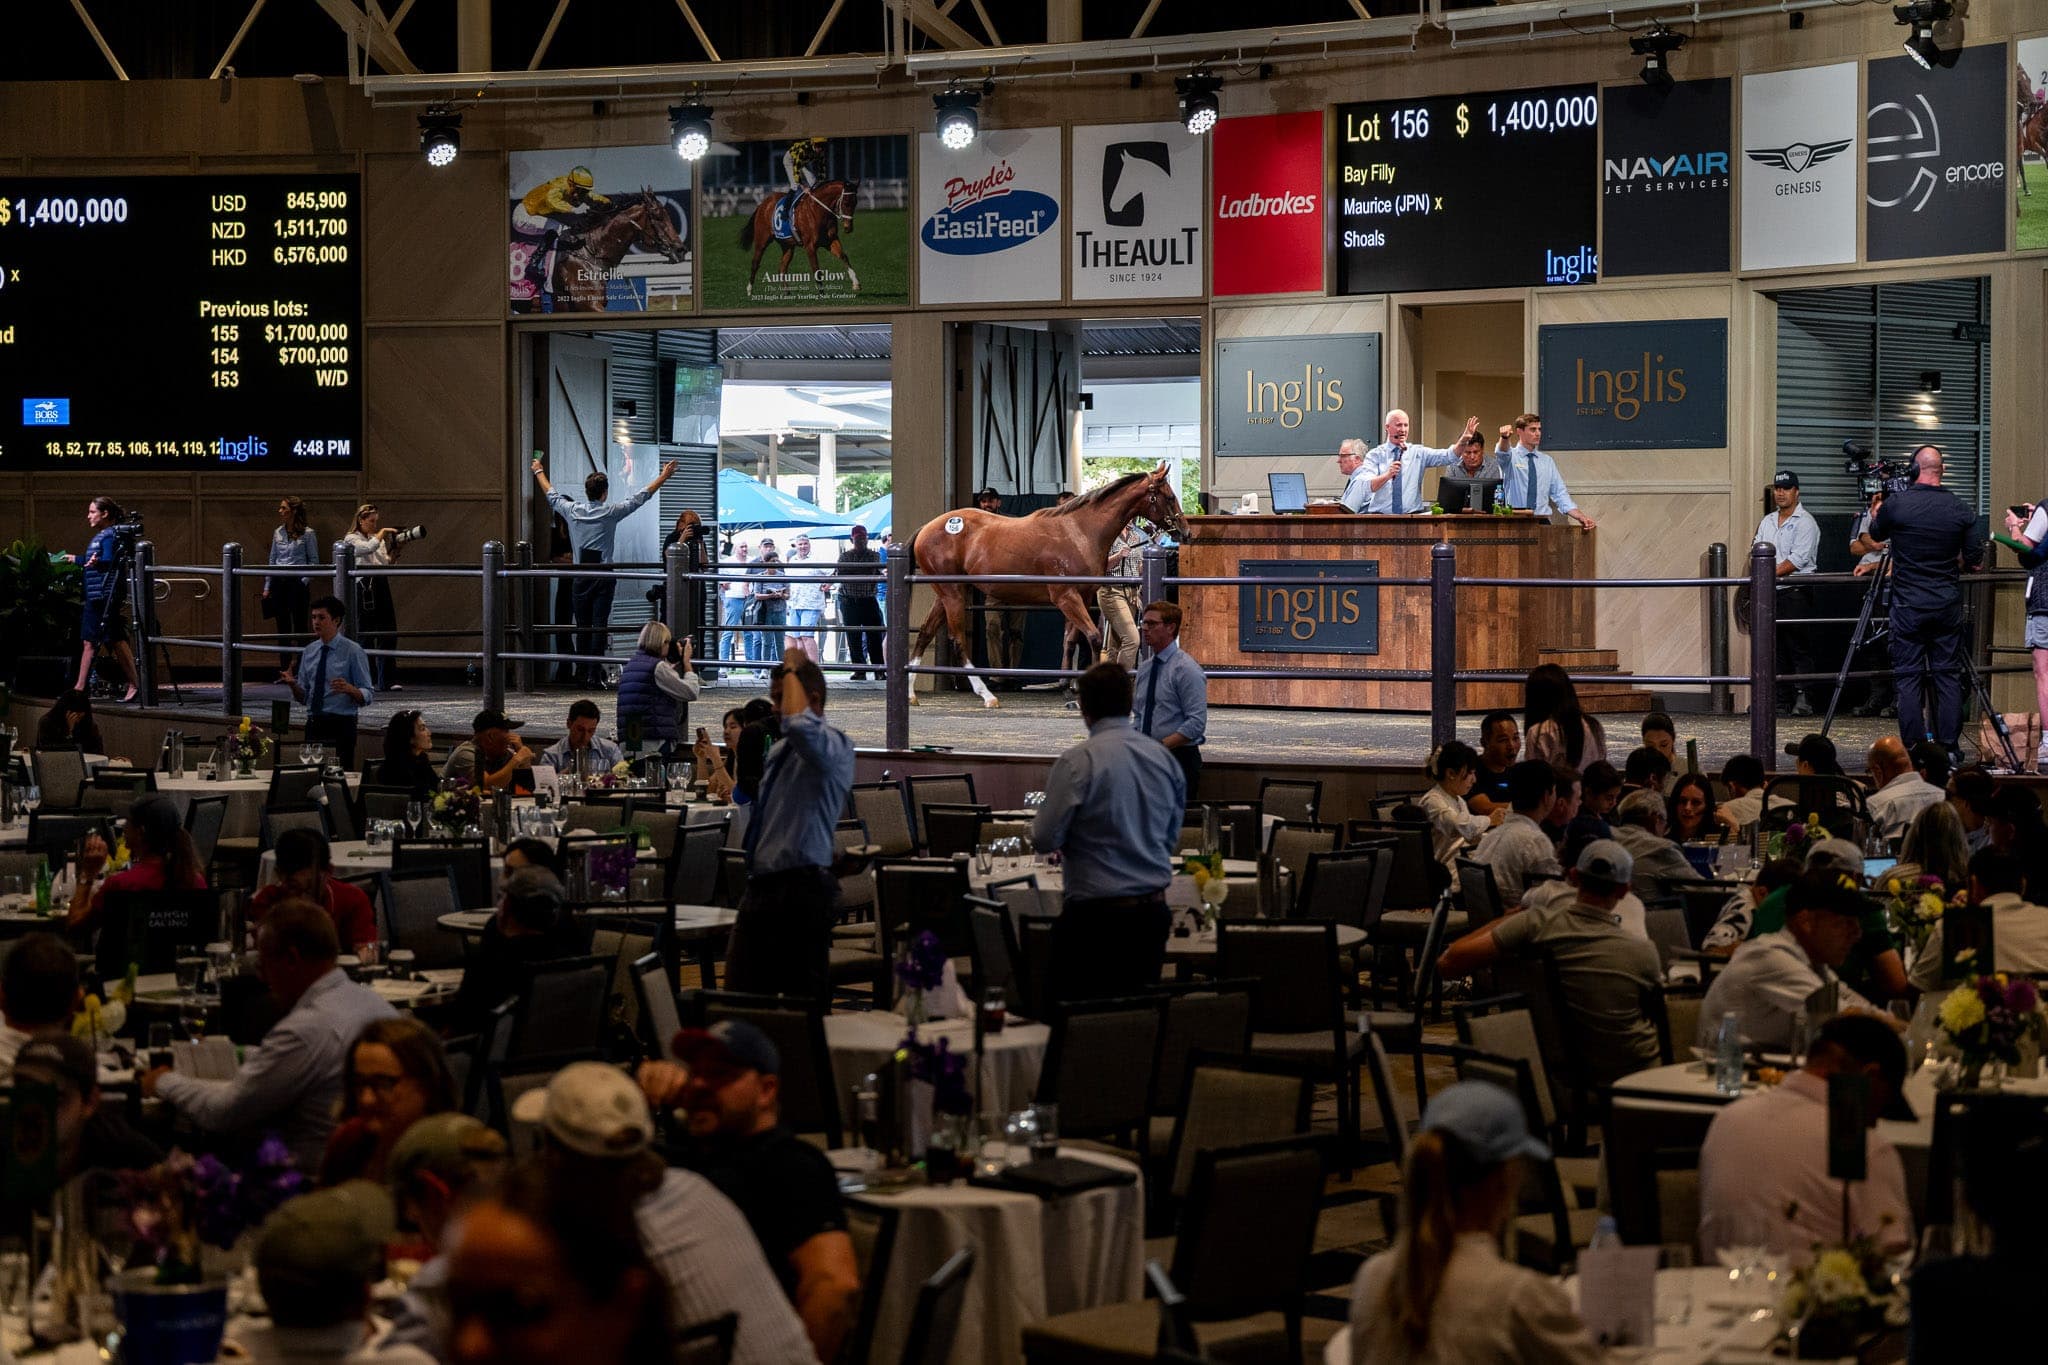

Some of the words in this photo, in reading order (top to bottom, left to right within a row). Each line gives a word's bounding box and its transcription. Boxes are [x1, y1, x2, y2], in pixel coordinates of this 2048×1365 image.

[1347, 113, 1381, 143] Lot
[1390, 108, 1429, 140] 156
[1456, 102, 1470, 138] $
[1487, 95, 1597, 137] 1,400,000
[1344, 165, 1368, 186] Bay
[1371, 163, 1396, 184] Filly
[1604, 151, 1729, 181] NAVAIR
[1945, 161, 2004, 183] encore
[944, 160, 1016, 206] Pryde's
[1605, 185, 1633, 195] JET
[1645, 179, 1729, 192] SERVICES
[1775, 181, 1821, 197] GENESIS
[0, 197, 11, 226] $
[15, 198, 128, 227] 1,400,000
[212, 195, 247, 212] USD
[287, 192, 347, 211] 845,900
[1219, 191, 1317, 219] Ladbrokes
[1344, 196, 1392, 216] Maurice
[1395, 193, 1431, 217] (JPN)
[1434, 197, 1443, 211] x
[212, 221, 246, 239] NZD
[274, 219, 348, 238] 1,511,700
[1344, 229, 1386, 248] Shoals
[213, 248, 247, 266] HKD
[274, 246, 348, 266] 6,576,000
[1076, 228, 1198, 268] THEAULT
[577, 267, 624, 281] Estriella
[1546, 245, 1597, 284] Inglis
[10, 269, 20, 282] x
[762, 271, 810, 283] Autumn
[814, 270, 846, 281] Glow
[1109, 274, 1136, 283] SINCE
[1141, 273, 1163, 281] 1924
[200, 301, 269, 318] Previous
[273, 300, 308, 317] lots:
[211, 325, 239, 342] 155
[265, 324, 348, 344] $1,700,000
[211, 348, 240, 365] 154
[279, 347, 348, 366] $700,000
[211, 371, 239, 388] 153
[316, 370, 348, 387] W/D
[1576, 352, 1687, 420] Inglis
[1247, 363, 1344, 428] Inglis
[35, 410, 58, 419] BOBS
[46, 442, 63, 457] 18,
[66, 442, 84, 457] 52,
[87, 442, 104, 457] 77,
[107, 442, 125, 457] 85,
[128, 442, 152, 457] 106,
[155, 442, 180, 457] 114,
[182, 441, 207, 457] 119,
[220, 435, 268, 461] Inglis
[293, 440, 323, 456] 4:48
[327, 440, 350, 456] PM
[1255, 571, 1361, 640] Inglis
